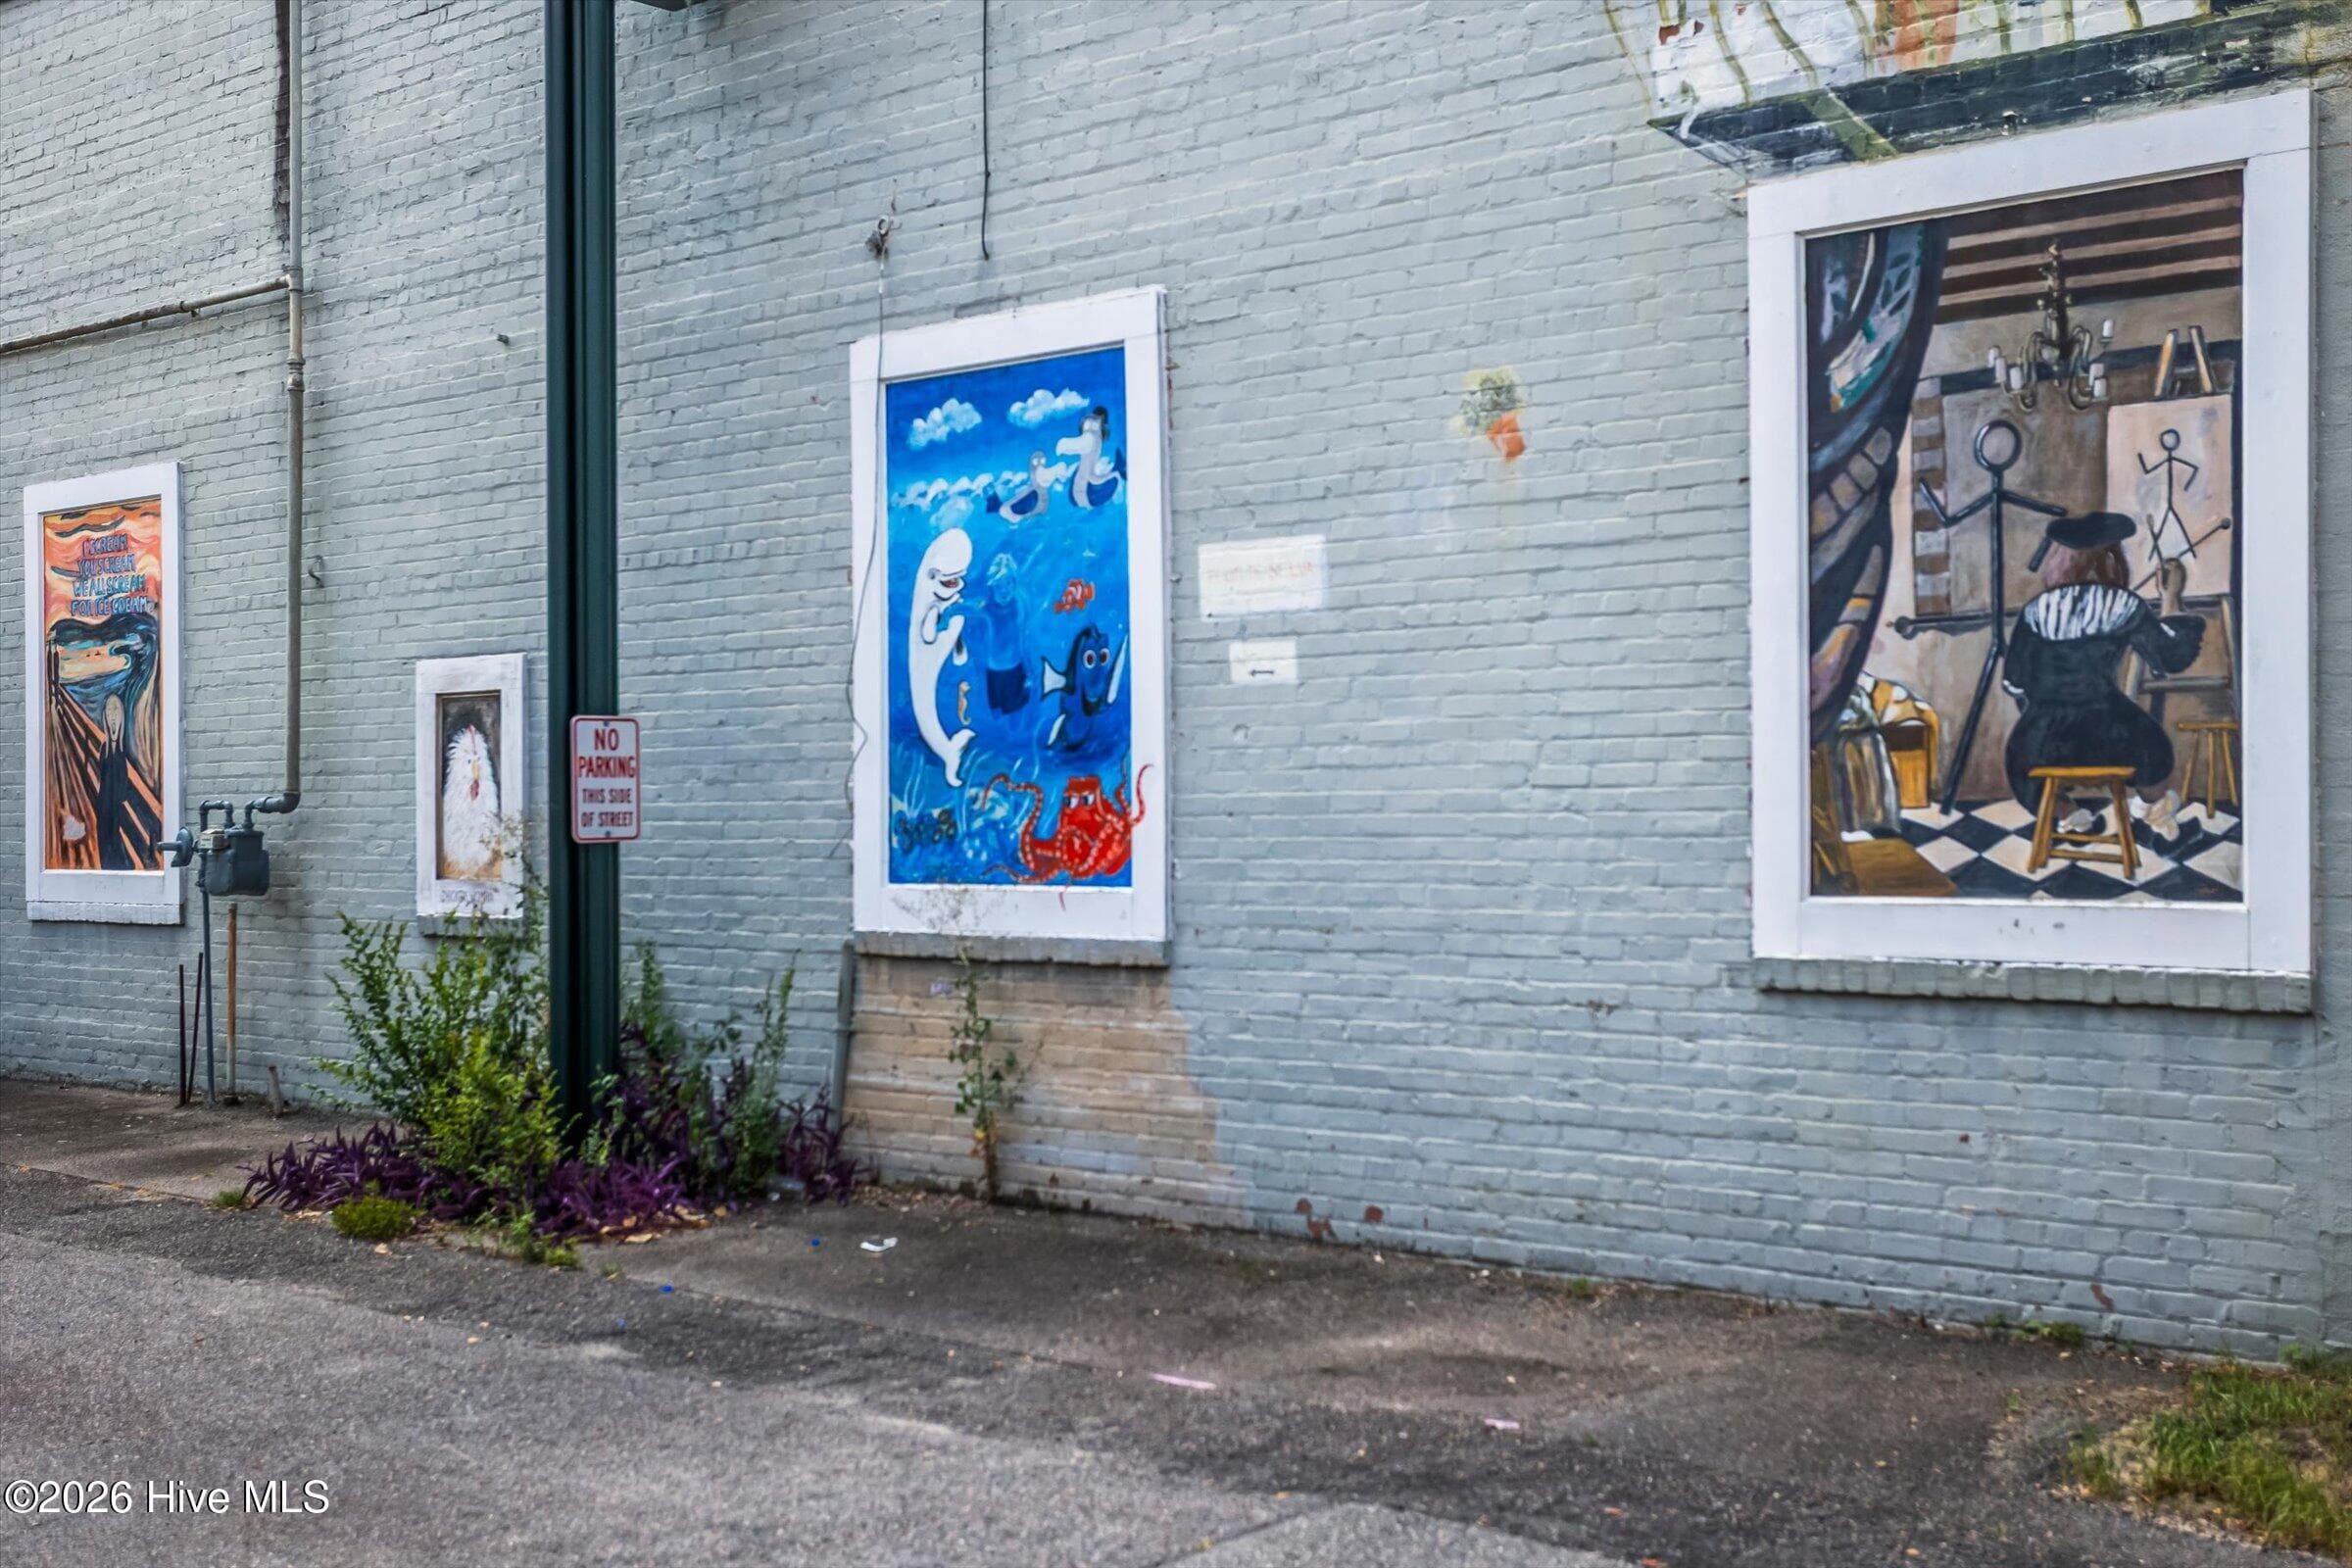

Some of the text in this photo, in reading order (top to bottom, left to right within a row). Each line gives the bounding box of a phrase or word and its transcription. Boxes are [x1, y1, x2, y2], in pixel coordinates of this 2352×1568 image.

[78, 559, 96, 577] YOU
[73, 578, 89, 597] WE
[89, 577, 107, 596] ALL
[71, 596, 147, 616] FOR ICE CREAM
[594, 728, 619, 751] NO
[578, 756, 636, 778] PARKING
[582, 788, 631, 804] THIS SIDE
[581, 811, 633, 827] OF STREET
